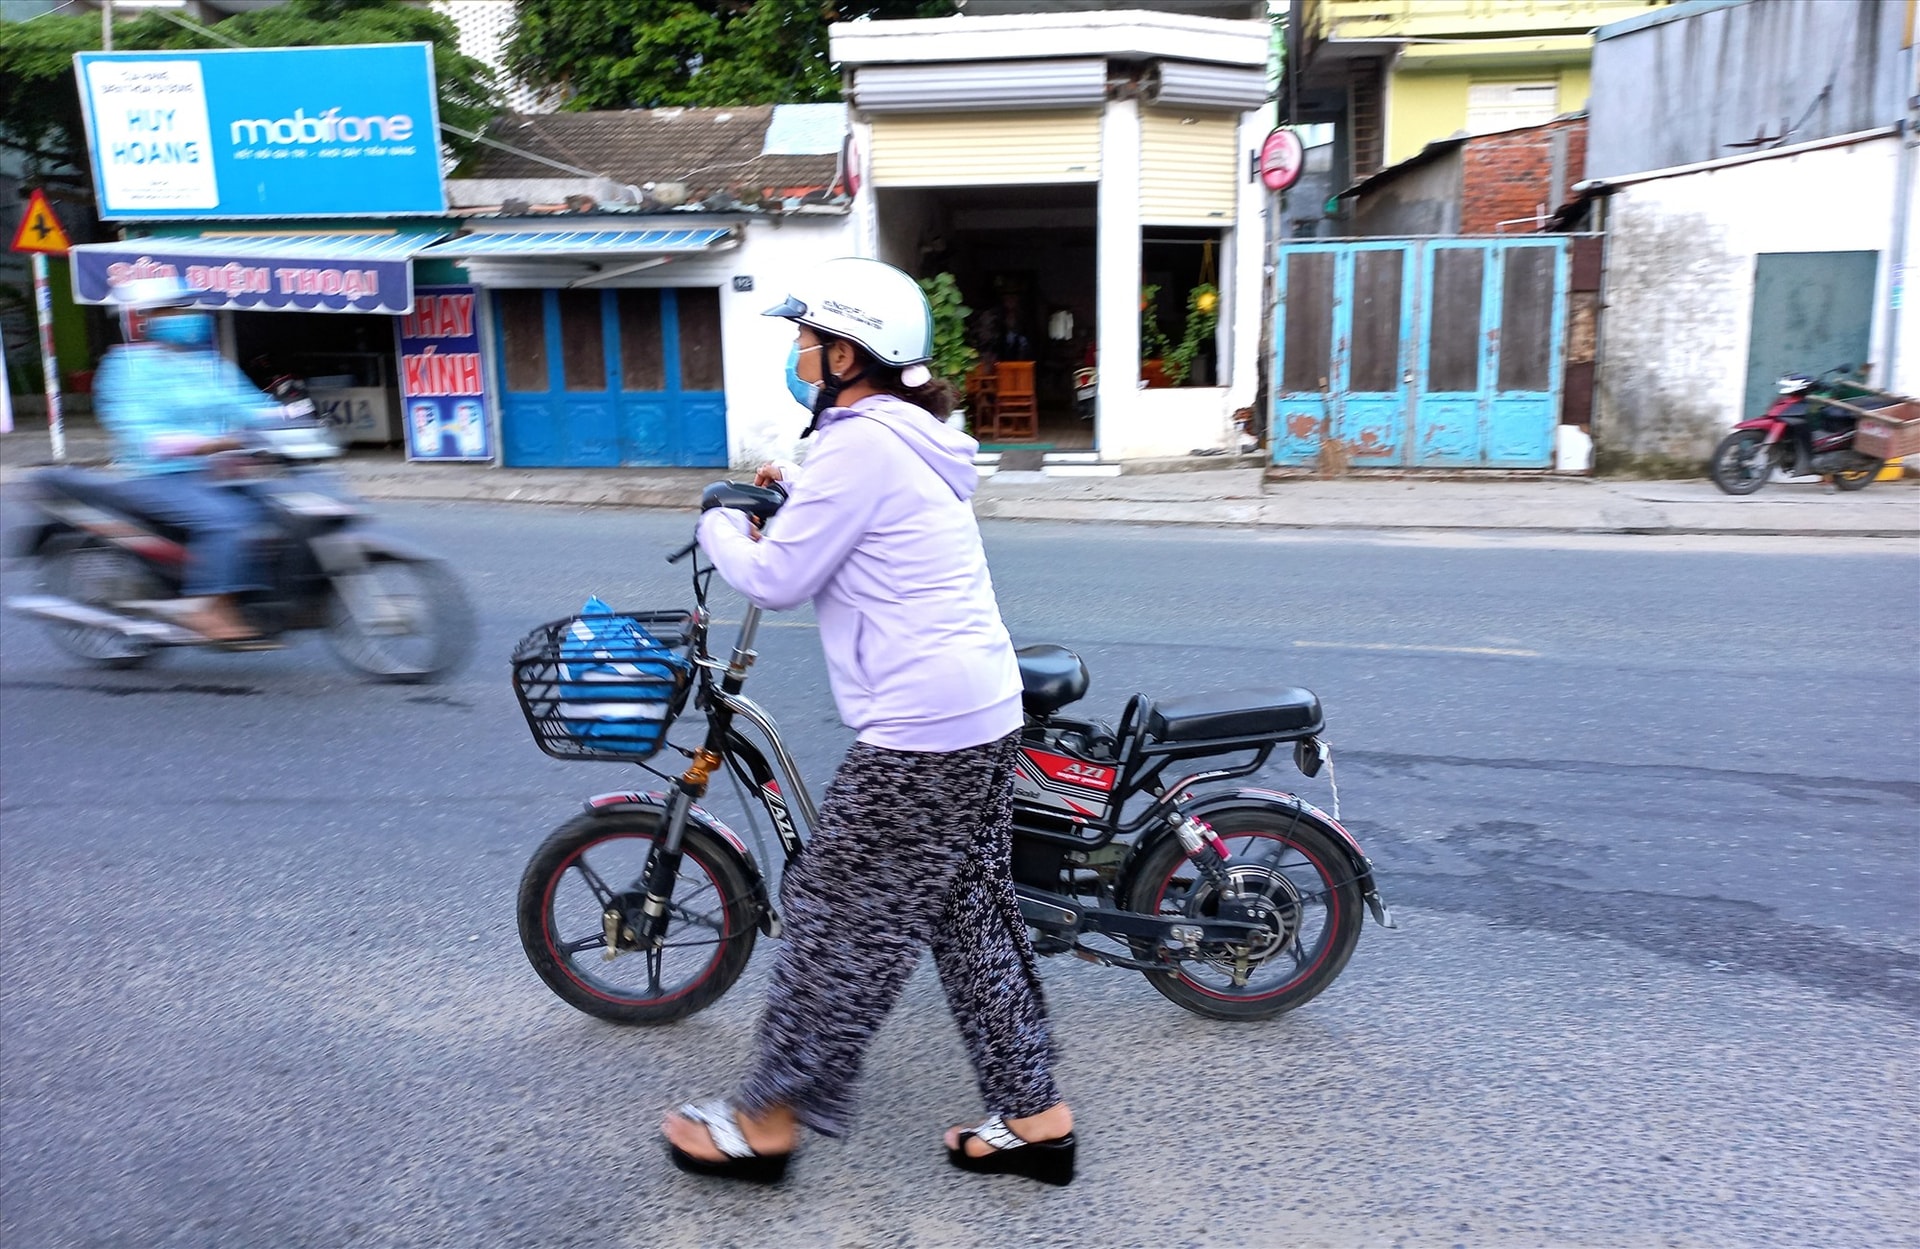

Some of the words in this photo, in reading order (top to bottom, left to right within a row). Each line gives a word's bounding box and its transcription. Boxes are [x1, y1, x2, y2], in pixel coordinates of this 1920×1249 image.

[126, 108, 176, 132] HUY
[230, 106, 413, 145] mobifone
[185, 262, 271, 298] ĐIỆN
[275, 267, 379, 301] THOẠI
[403, 345, 484, 397] KÍNH
[1062, 763, 1106, 779] AZI
